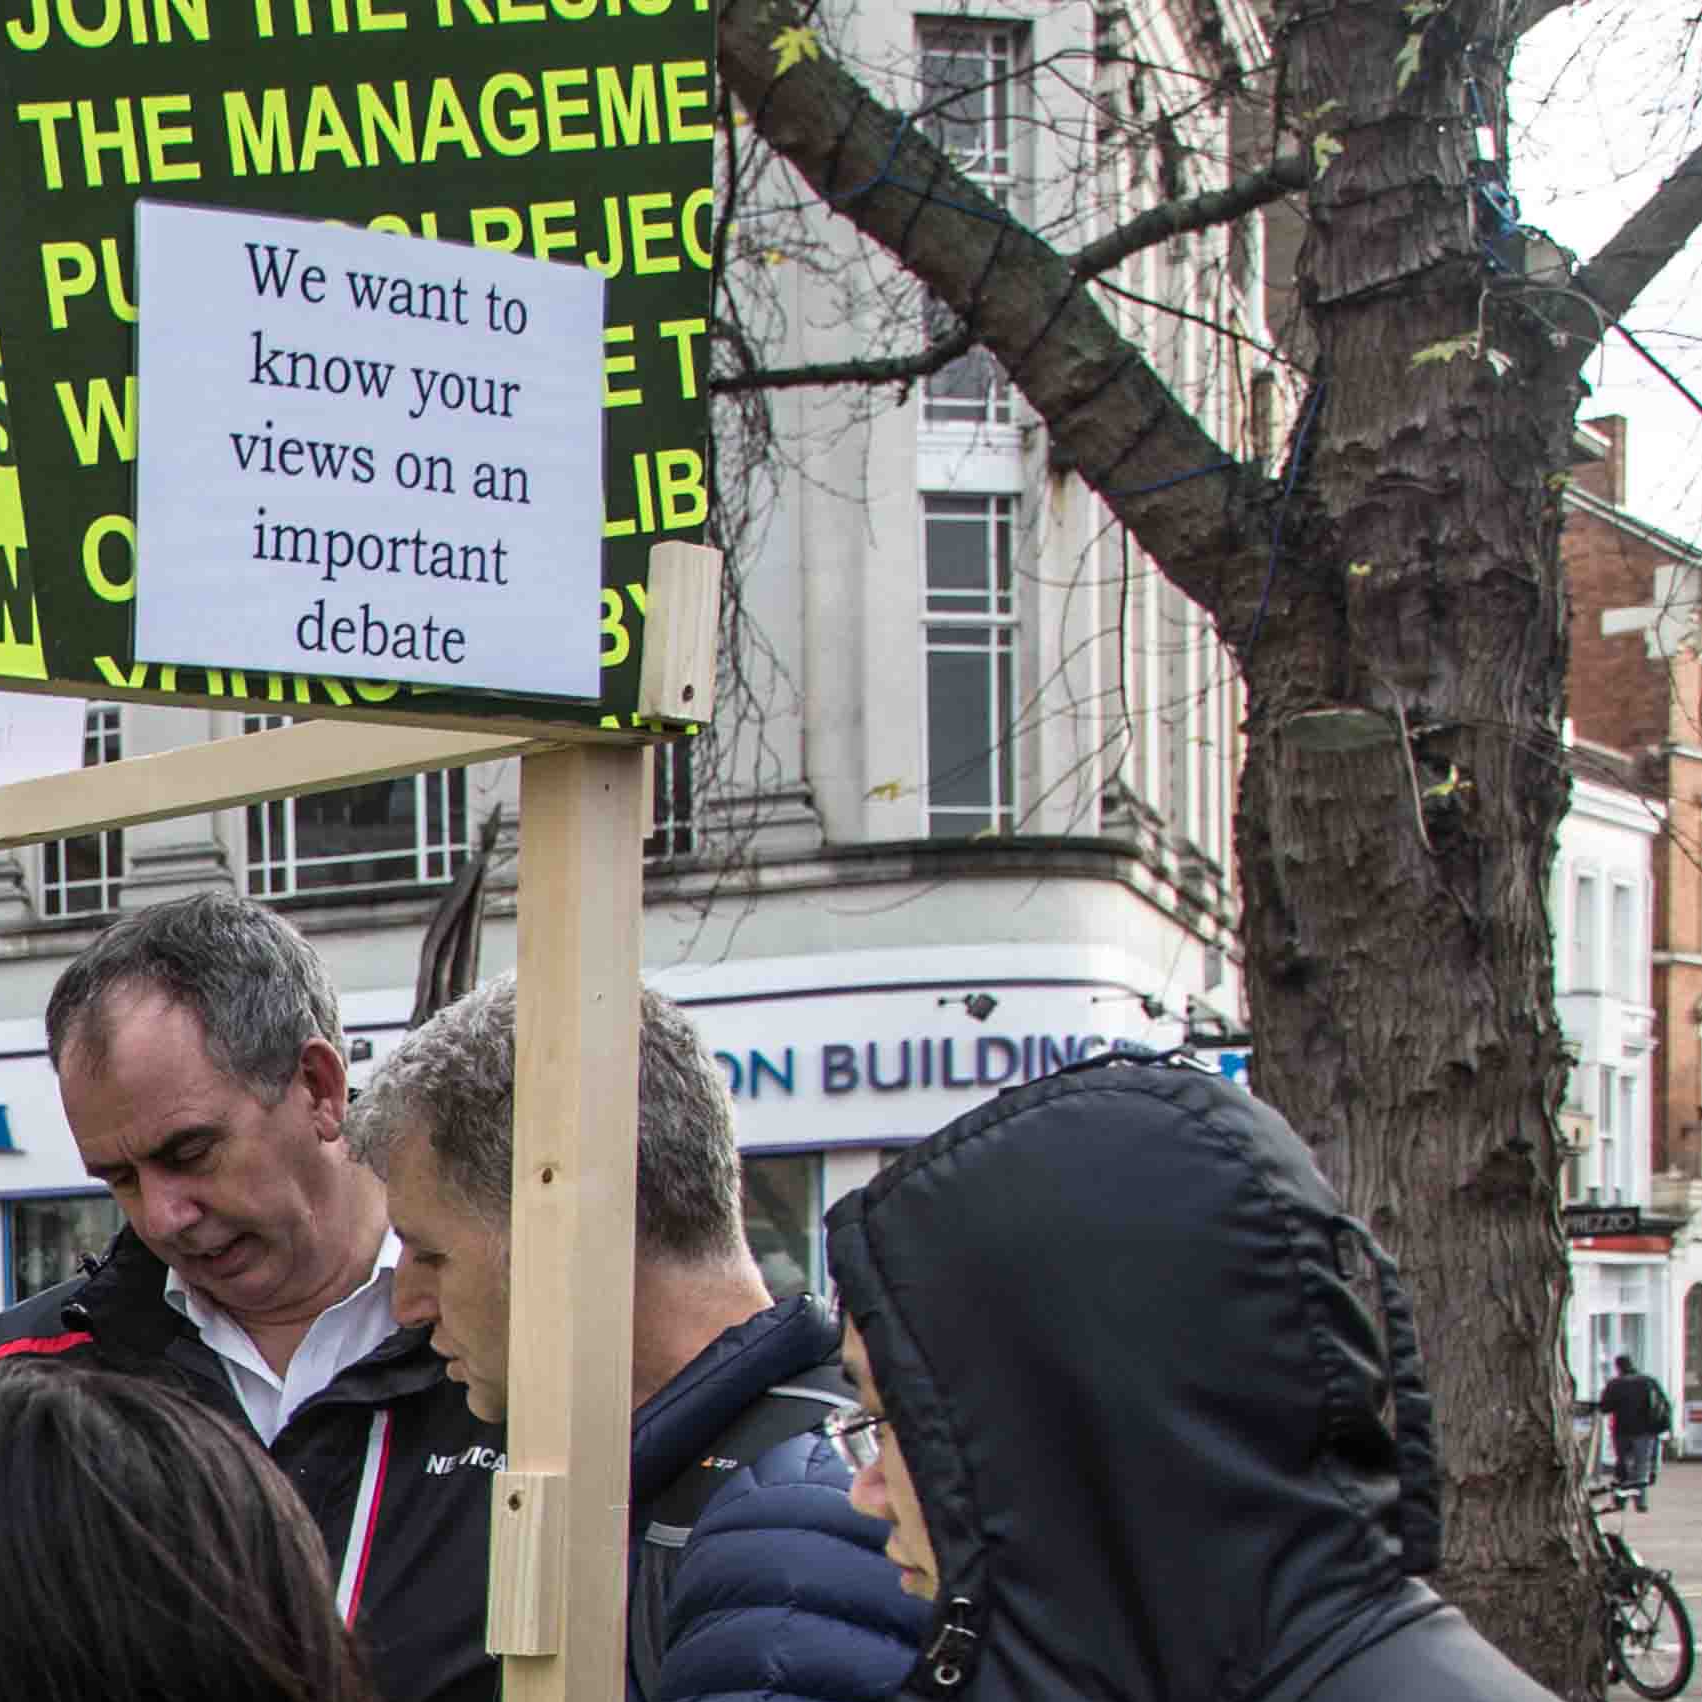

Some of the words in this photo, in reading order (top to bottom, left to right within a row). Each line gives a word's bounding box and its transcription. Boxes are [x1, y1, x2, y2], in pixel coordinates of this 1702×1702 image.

[18, 94, 201, 190] THE
[224, 60, 714, 178] MANAGEME
[244, 242, 327, 303] We
[346, 270, 470, 327] want
[485, 290, 529, 336] to
[249, 331, 395, 400] know
[408, 362, 521, 419] your
[229, 420, 375, 485] views
[396, 450, 455, 496] on
[473, 459, 531, 505] an
[252, 507, 509, 587] important
[296, 600, 467, 666] debate
